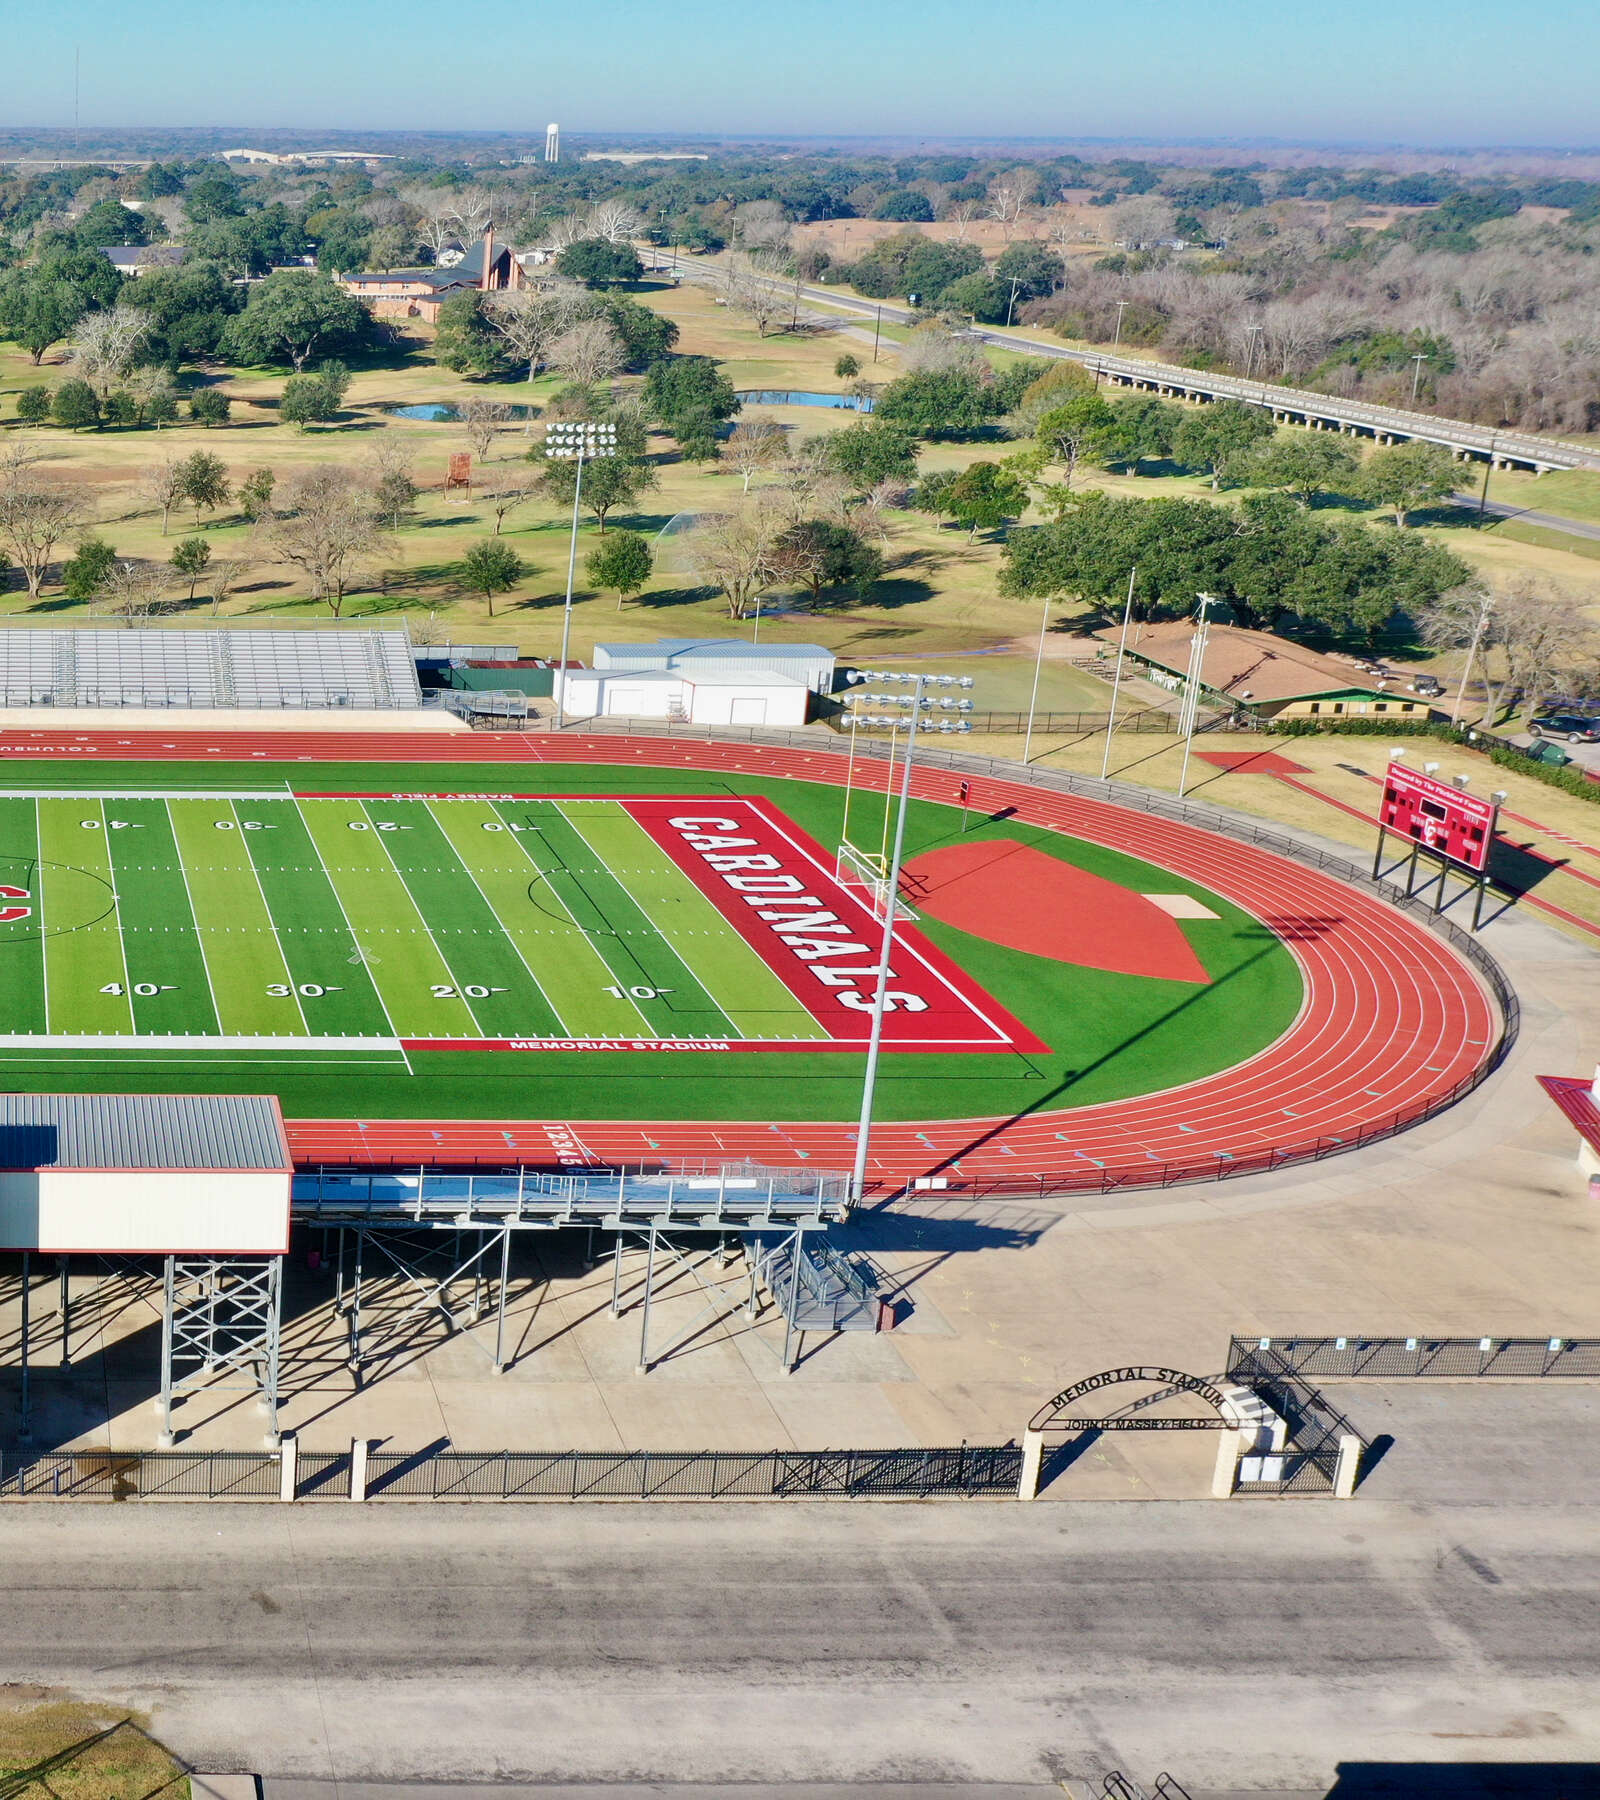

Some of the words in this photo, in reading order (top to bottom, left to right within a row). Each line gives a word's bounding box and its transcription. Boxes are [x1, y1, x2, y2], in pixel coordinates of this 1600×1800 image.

[80, 820, 129, 830] 40
[214, 821, 264, 830] 30
[348, 822, 397, 831] 20
[482, 822, 531, 831] 10
[667, 816, 930, 1013] CARDINALS
[99, 983, 161, 996] 40
[265, 984, 326, 998] 30
[430, 985, 491, 999] 20
[603, 986, 659, 999] 10
[510, 1040, 628, 1050] MEMORIAL
[631, 1041, 731, 1051] STADIUM
[1050, 1368, 1146, 1411] MEMORIAL
[1157, 1368, 1226, 1409] STADIUM
[1065, 1420, 1099, 1430] JOHN
[1117, 1419, 1171, 1429] MASSEY
[1173, 1419, 1207, 1429] FIELD
